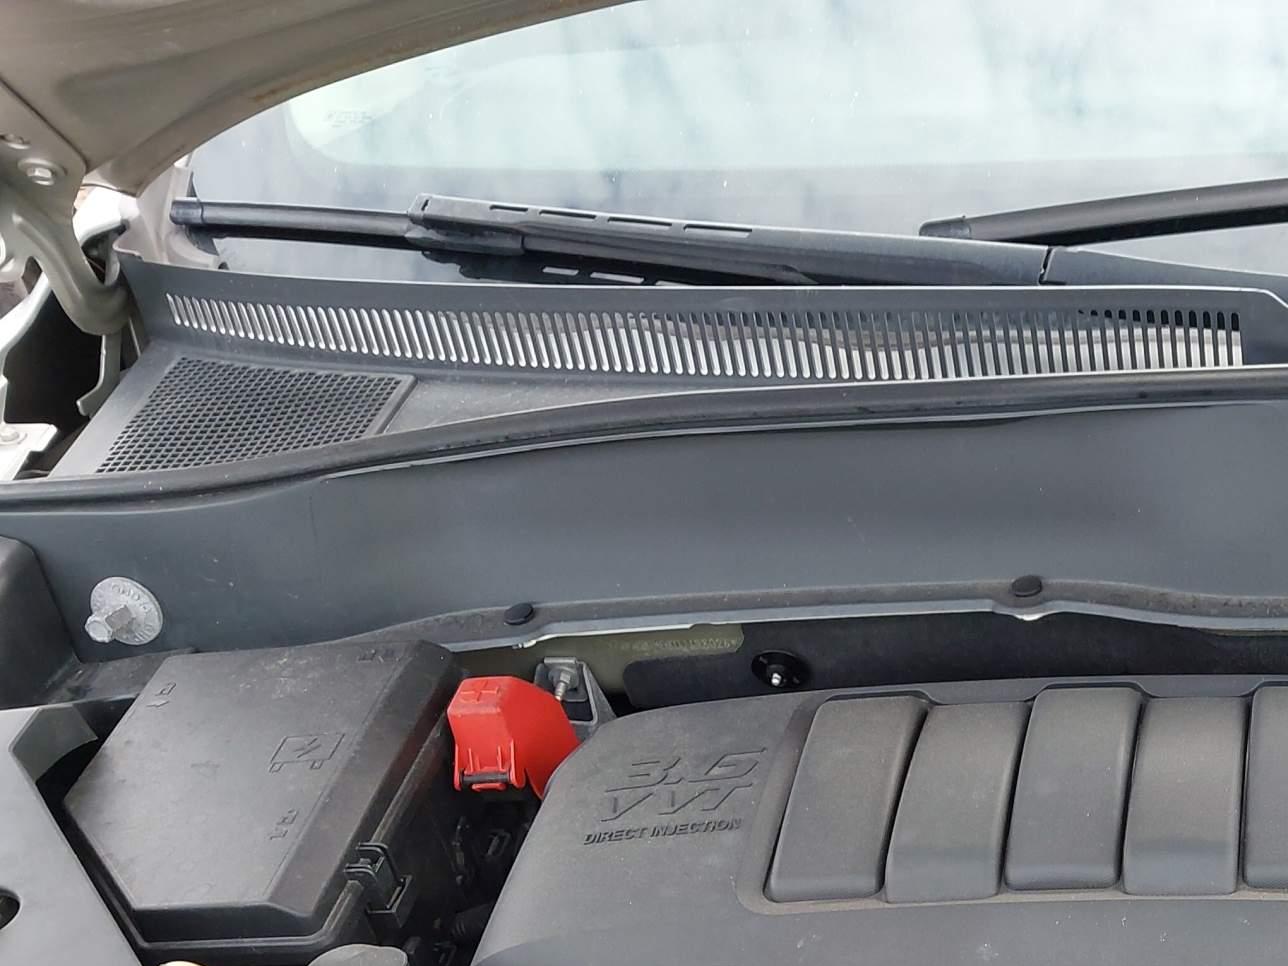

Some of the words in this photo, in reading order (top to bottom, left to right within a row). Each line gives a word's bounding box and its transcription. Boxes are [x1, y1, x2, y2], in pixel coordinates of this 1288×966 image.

[604, 747, 767, 793] 3.6
[600, 783, 753, 822] VVT
[584, 826, 648, 845] DIRECT
[649, 818, 743, 837] INJECTION
